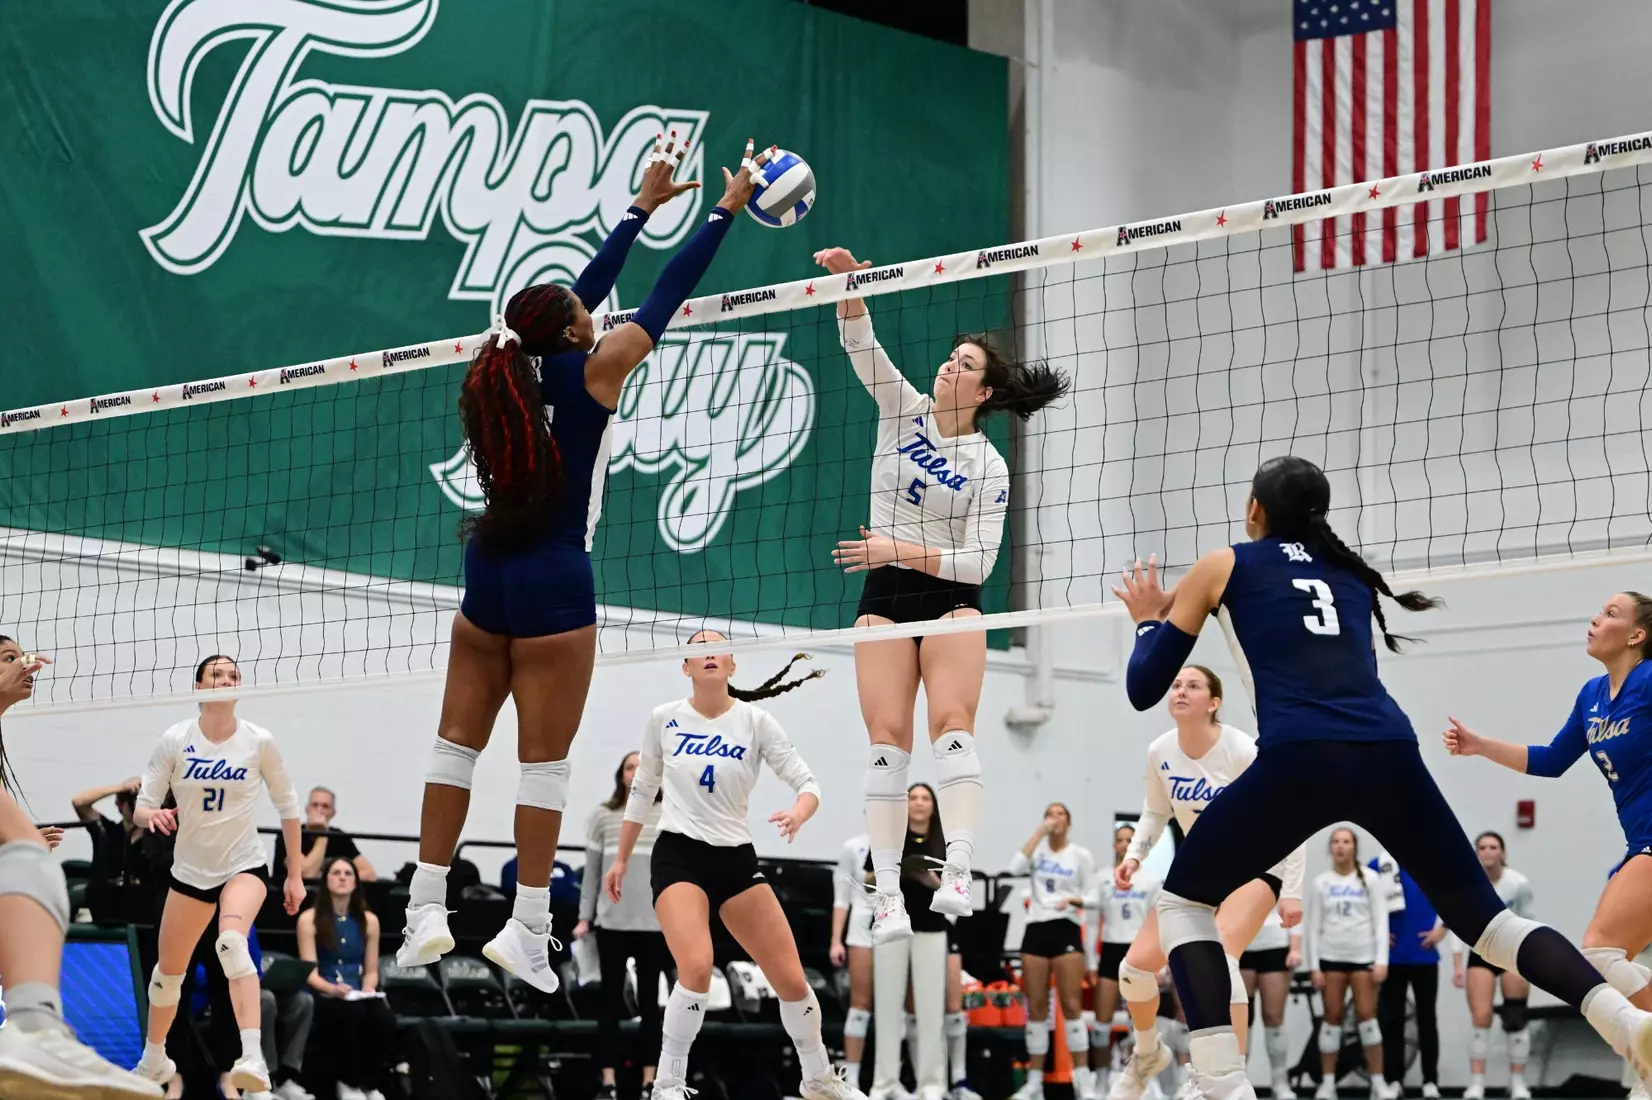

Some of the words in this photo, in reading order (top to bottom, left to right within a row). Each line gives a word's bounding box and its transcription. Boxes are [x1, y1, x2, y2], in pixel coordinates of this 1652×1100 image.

[139, 0, 710, 301] Tampa
[1, 410, 41, 428] AMERICAN
[90, 397, 132, 414] AMERICAN
[182, 381, 226, 400] AMERICAN
[280, 364, 325, 384] AMERICAN
[382, 347, 431, 368] AMERICAN
[602, 312, 636, 331] AMER
[720, 288, 776, 313] AMERICAN
[846, 267, 904, 291] AMERICAN
[975, 244, 1039, 269] AMERICAN
[1116, 220, 1182, 247] AMERICAN
[1263, 193, 1332, 221] AMERICAN
[1417, 165, 1492, 193] AMERICAN
[1583, 136, 1652, 165] AMERICA
[896, 431, 968, 492] Tulsa
[906, 477, 927, 506] 5
[1291, 578, 1340, 635] 3
[673, 732, 747, 761] Tulsa
[182, 757, 249, 781] Tulsa
[699, 764, 716, 794] 4
[202, 787, 225, 812] 21
[1336, 900, 1352, 917] 12
